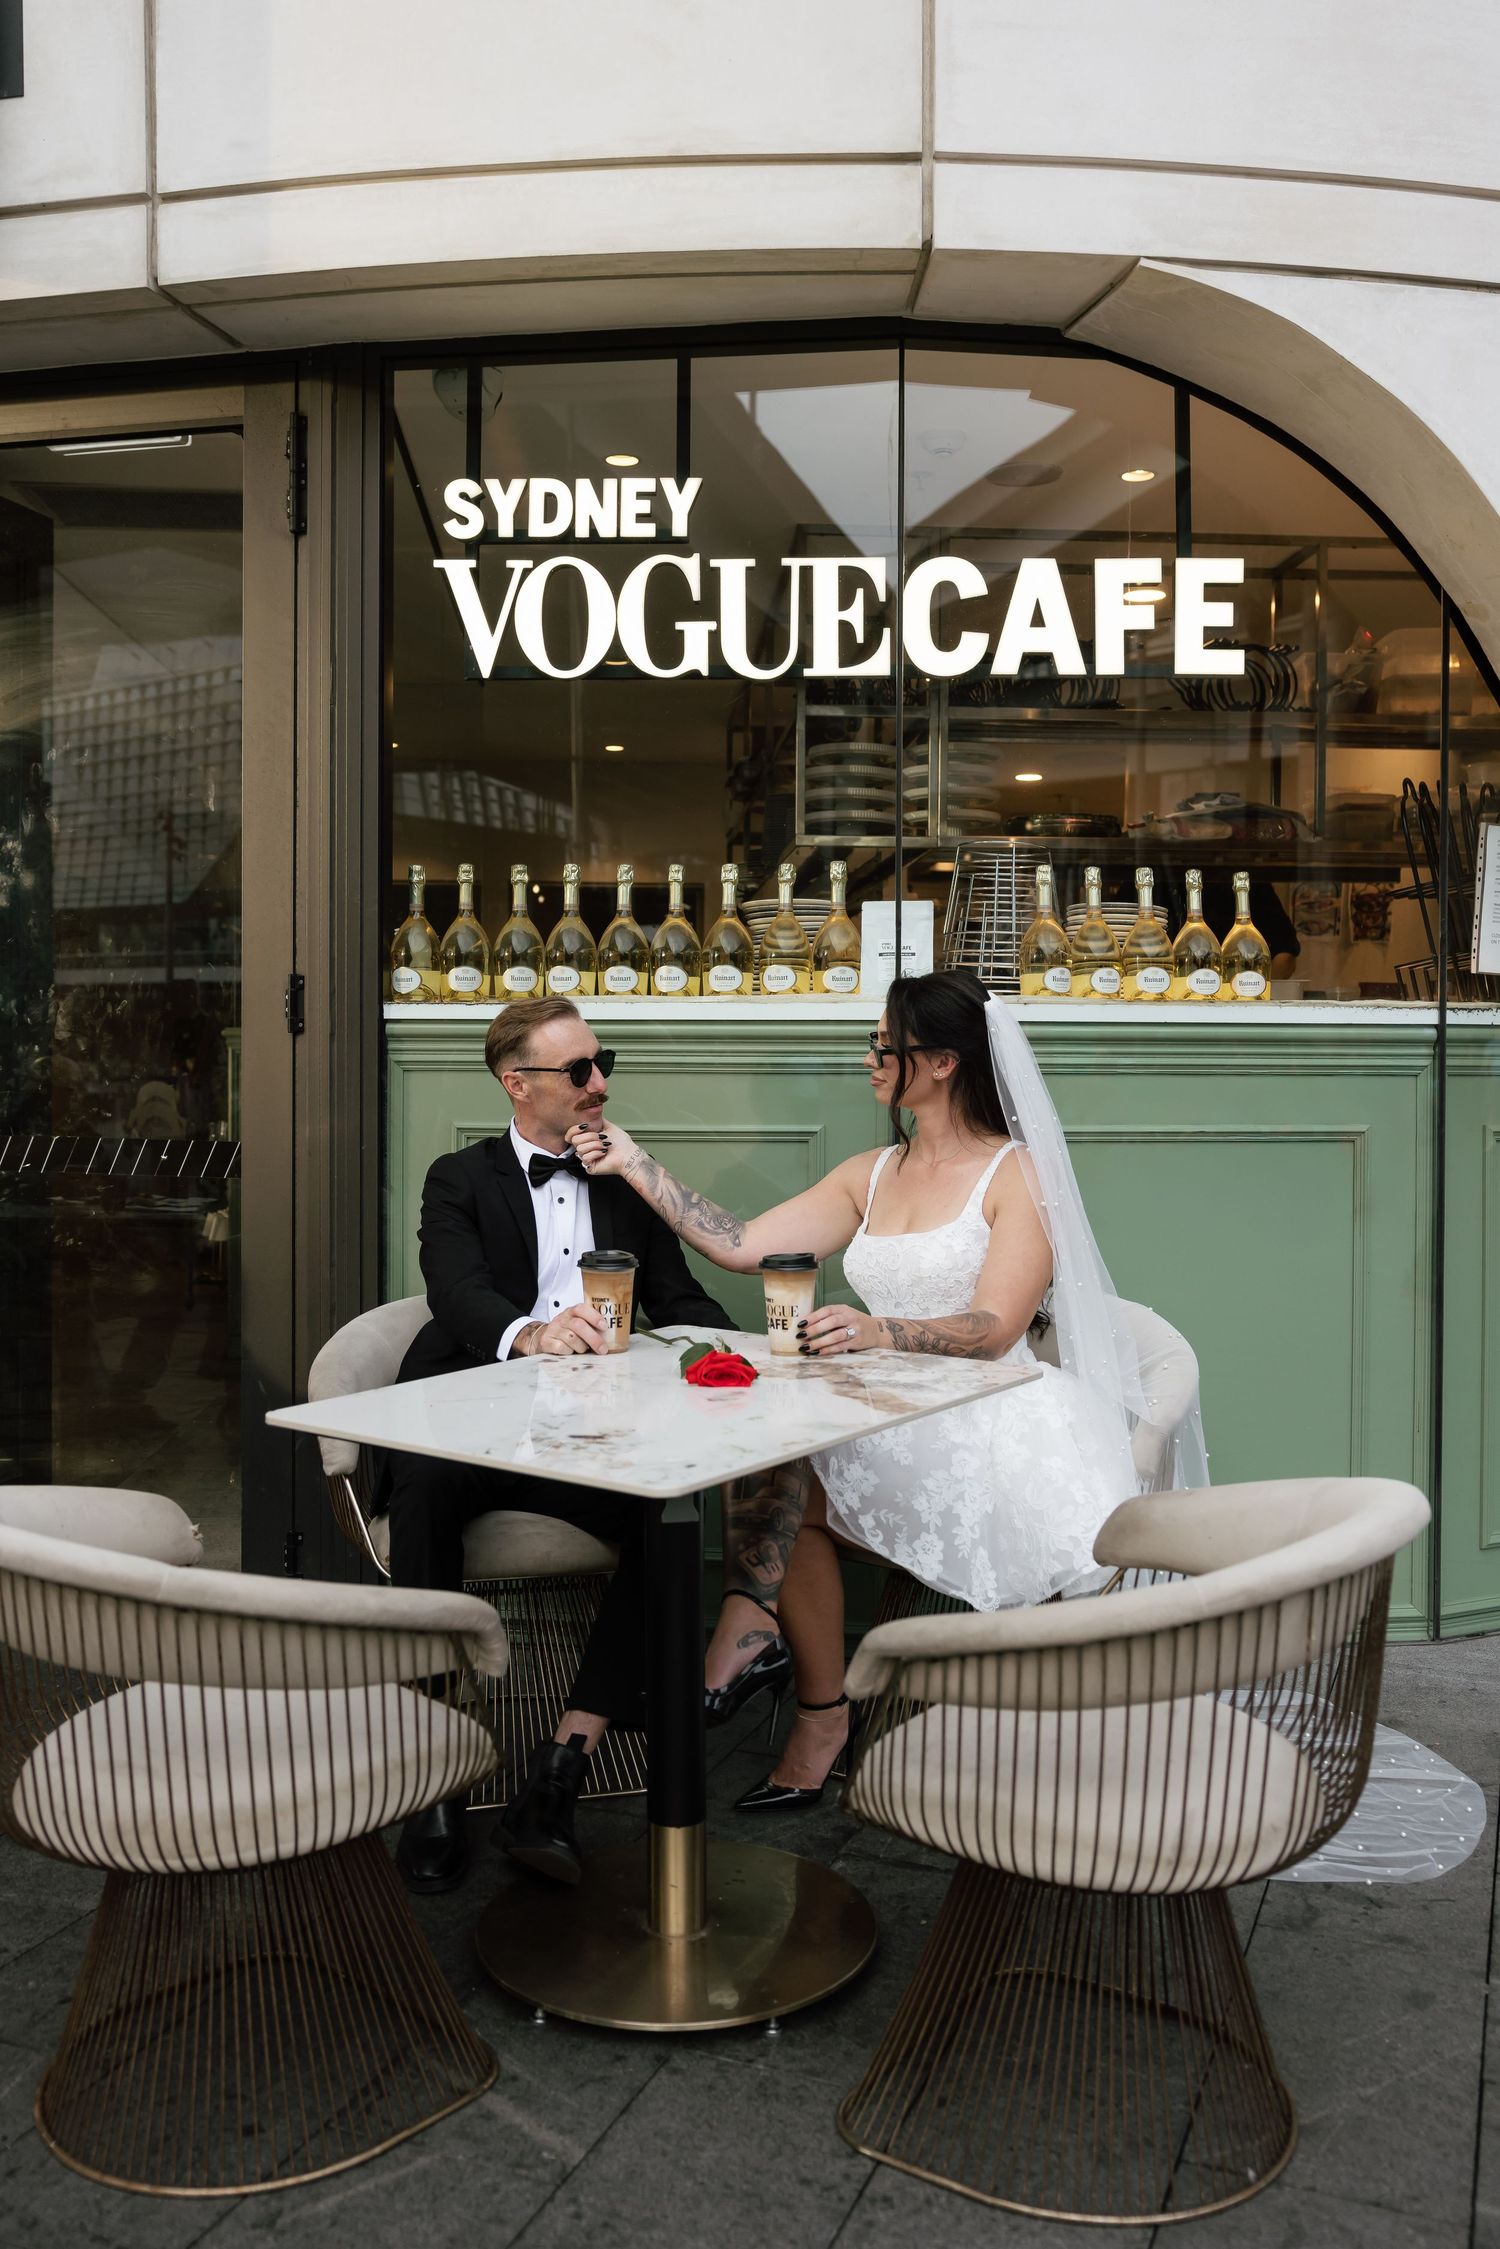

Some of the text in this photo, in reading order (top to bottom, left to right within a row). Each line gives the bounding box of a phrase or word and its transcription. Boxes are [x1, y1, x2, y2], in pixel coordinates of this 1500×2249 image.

[444, 478, 701, 539] SYDNEY
[434, 554, 1244, 679] VOGUE CAFE
[767, 1305, 799, 1317] OGUE
